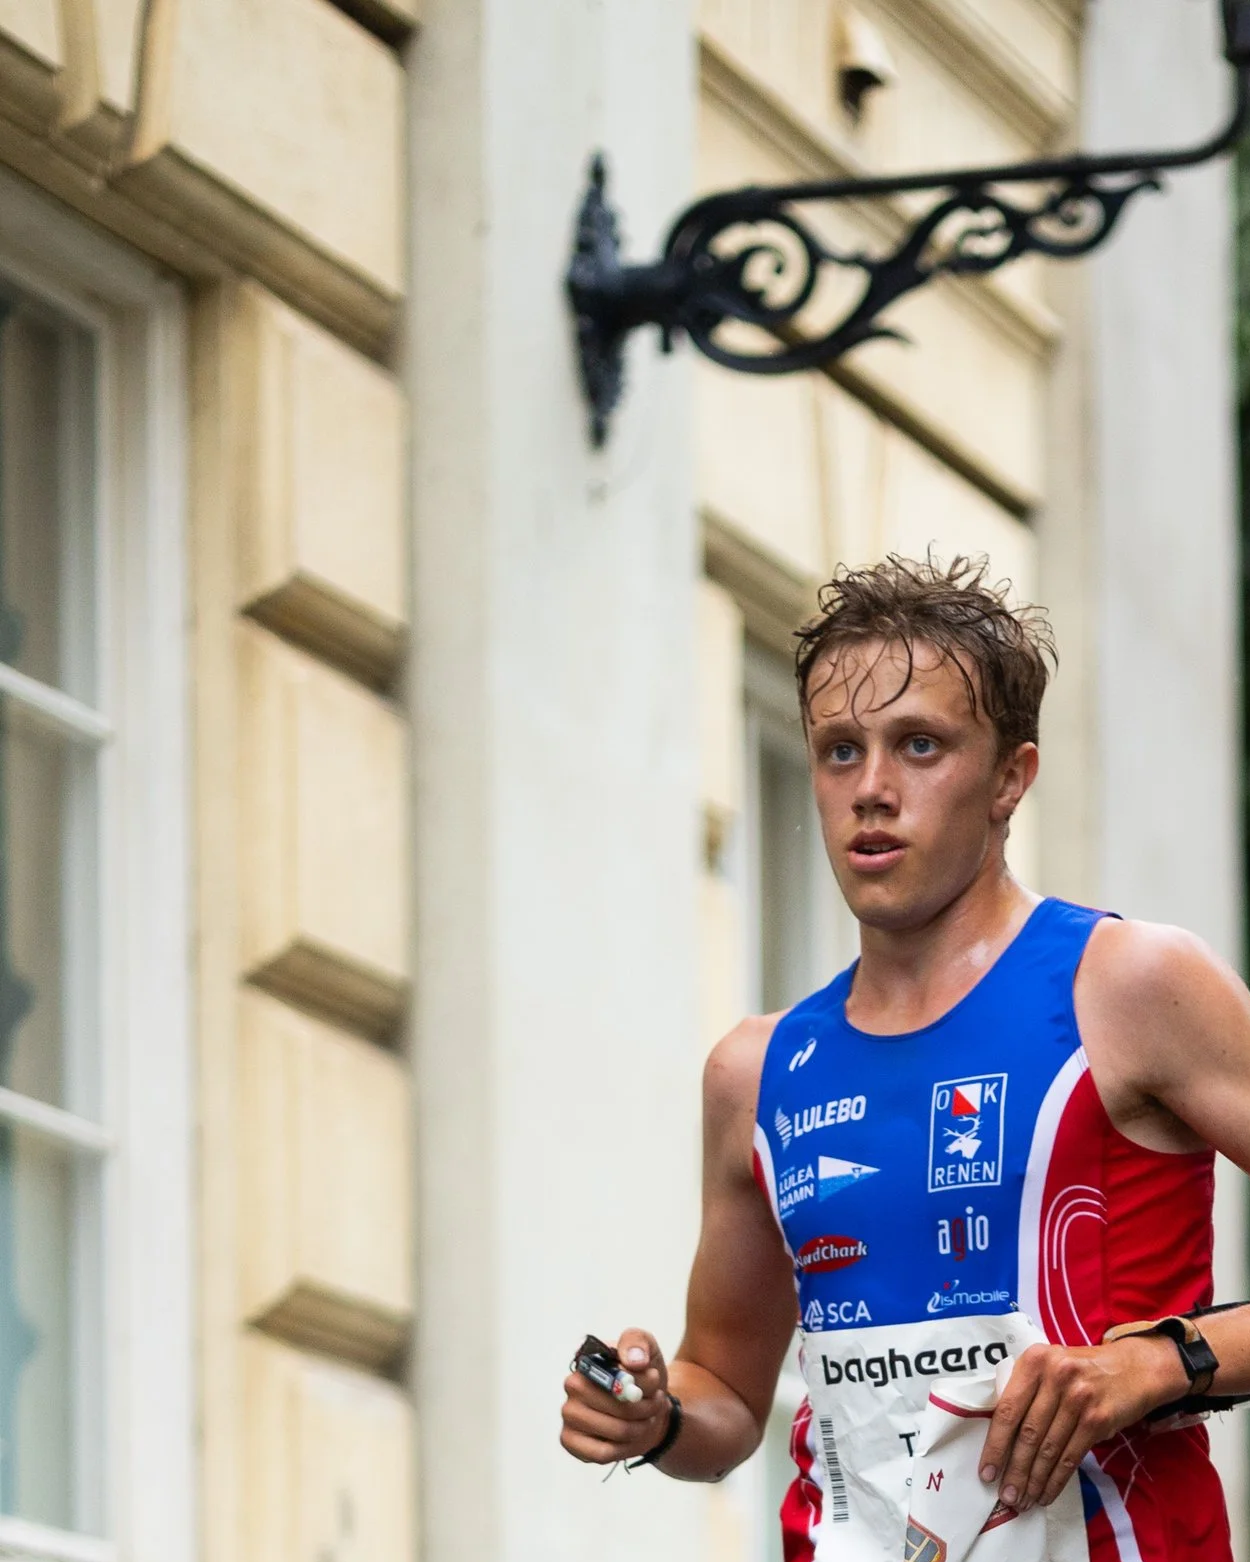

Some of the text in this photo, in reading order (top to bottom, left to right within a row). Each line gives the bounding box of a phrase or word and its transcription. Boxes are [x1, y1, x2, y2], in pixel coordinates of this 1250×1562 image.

[794, 1095, 867, 1138] LULEBO
[935, 1161, 996, 1186] RENEN
[779, 1183, 815, 1212] HAMN
[937, 1206, 989, 1262] agio
[827, 1299, 872, 1324] SCA
[821, 1341, 1008, 1388] bagheera
